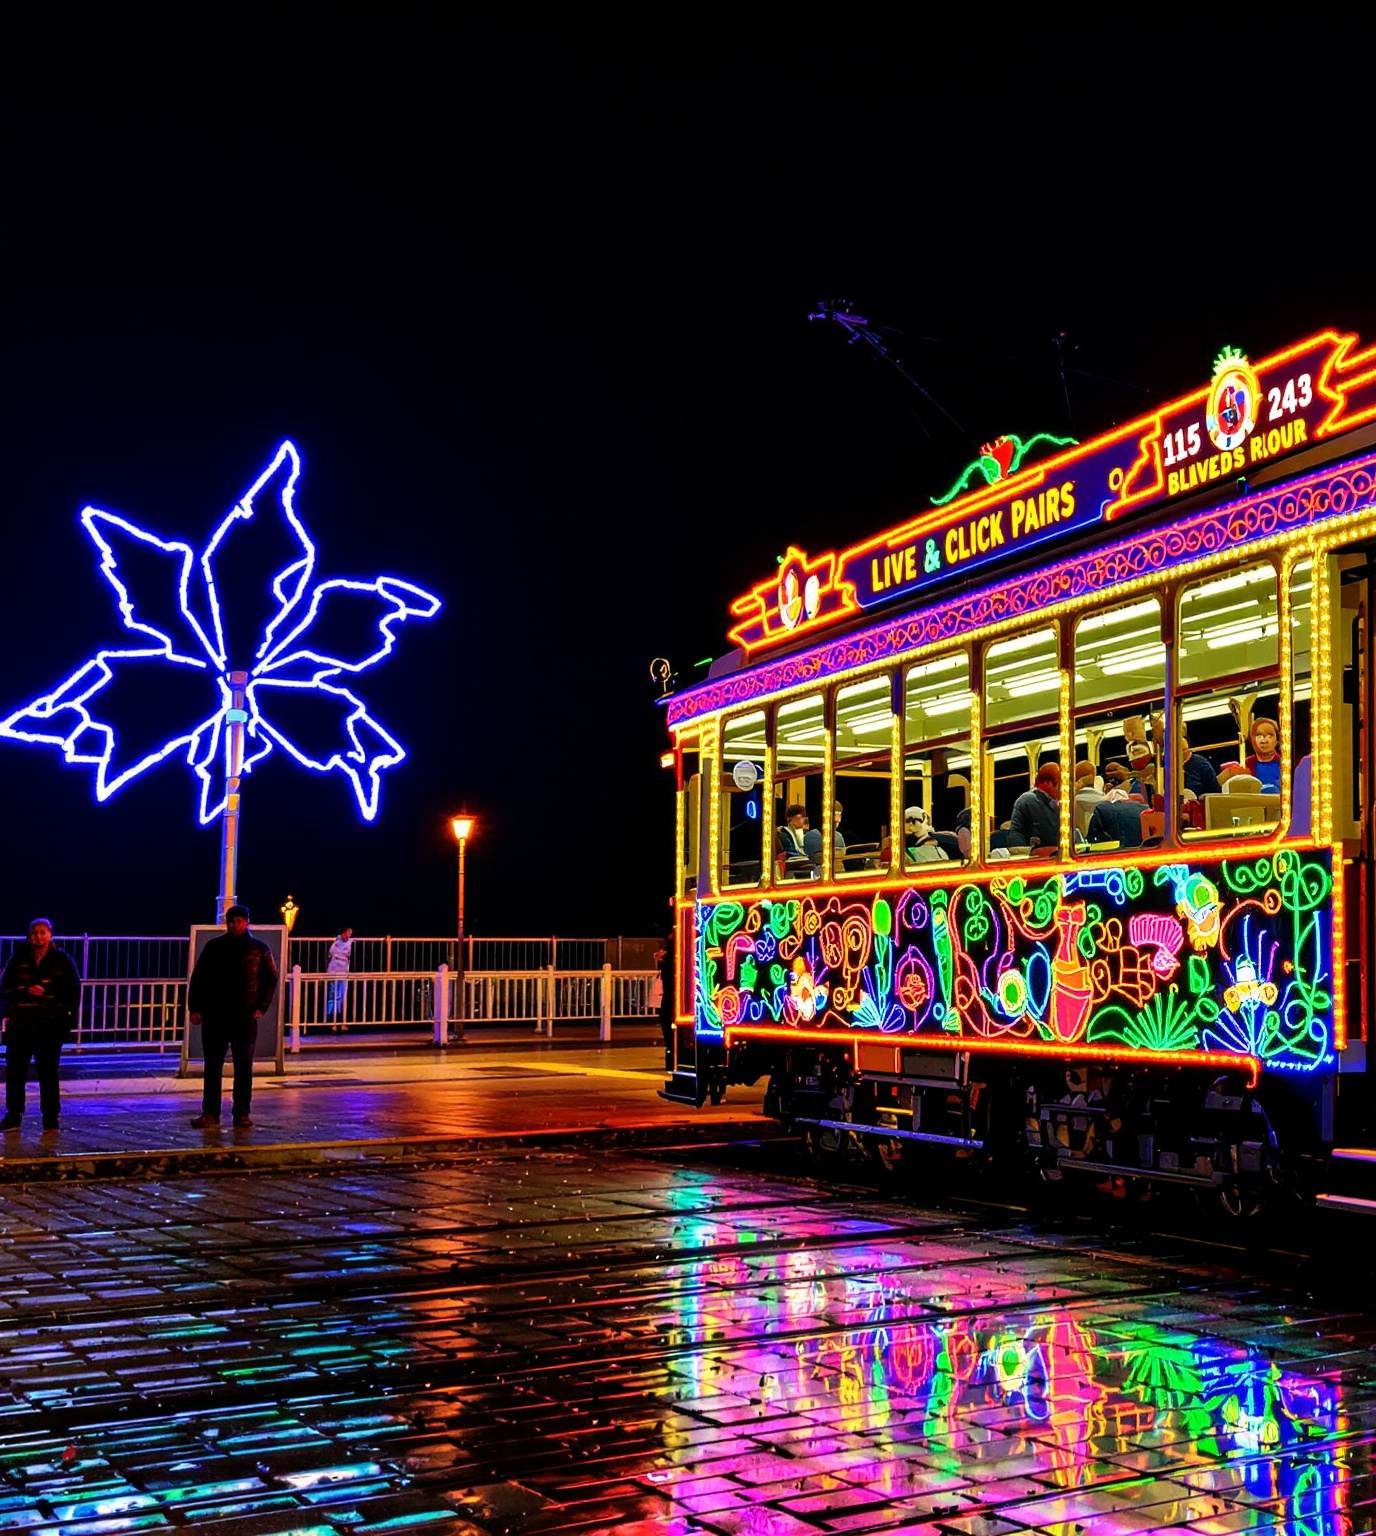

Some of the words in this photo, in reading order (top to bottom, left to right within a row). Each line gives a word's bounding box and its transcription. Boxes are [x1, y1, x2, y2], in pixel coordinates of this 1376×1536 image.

[1268, 373, 1313, 422] 243
[1163, 422, 1201, 467] 115
[1167, 446, 1246, 496] BLAVEDS
[871, 545, 917, 592] LIVE
[924, 539, 941, 573] &
[945, 511, 1005, 564] CLICK
[1011, 481, 1076, 539] PAIRS
